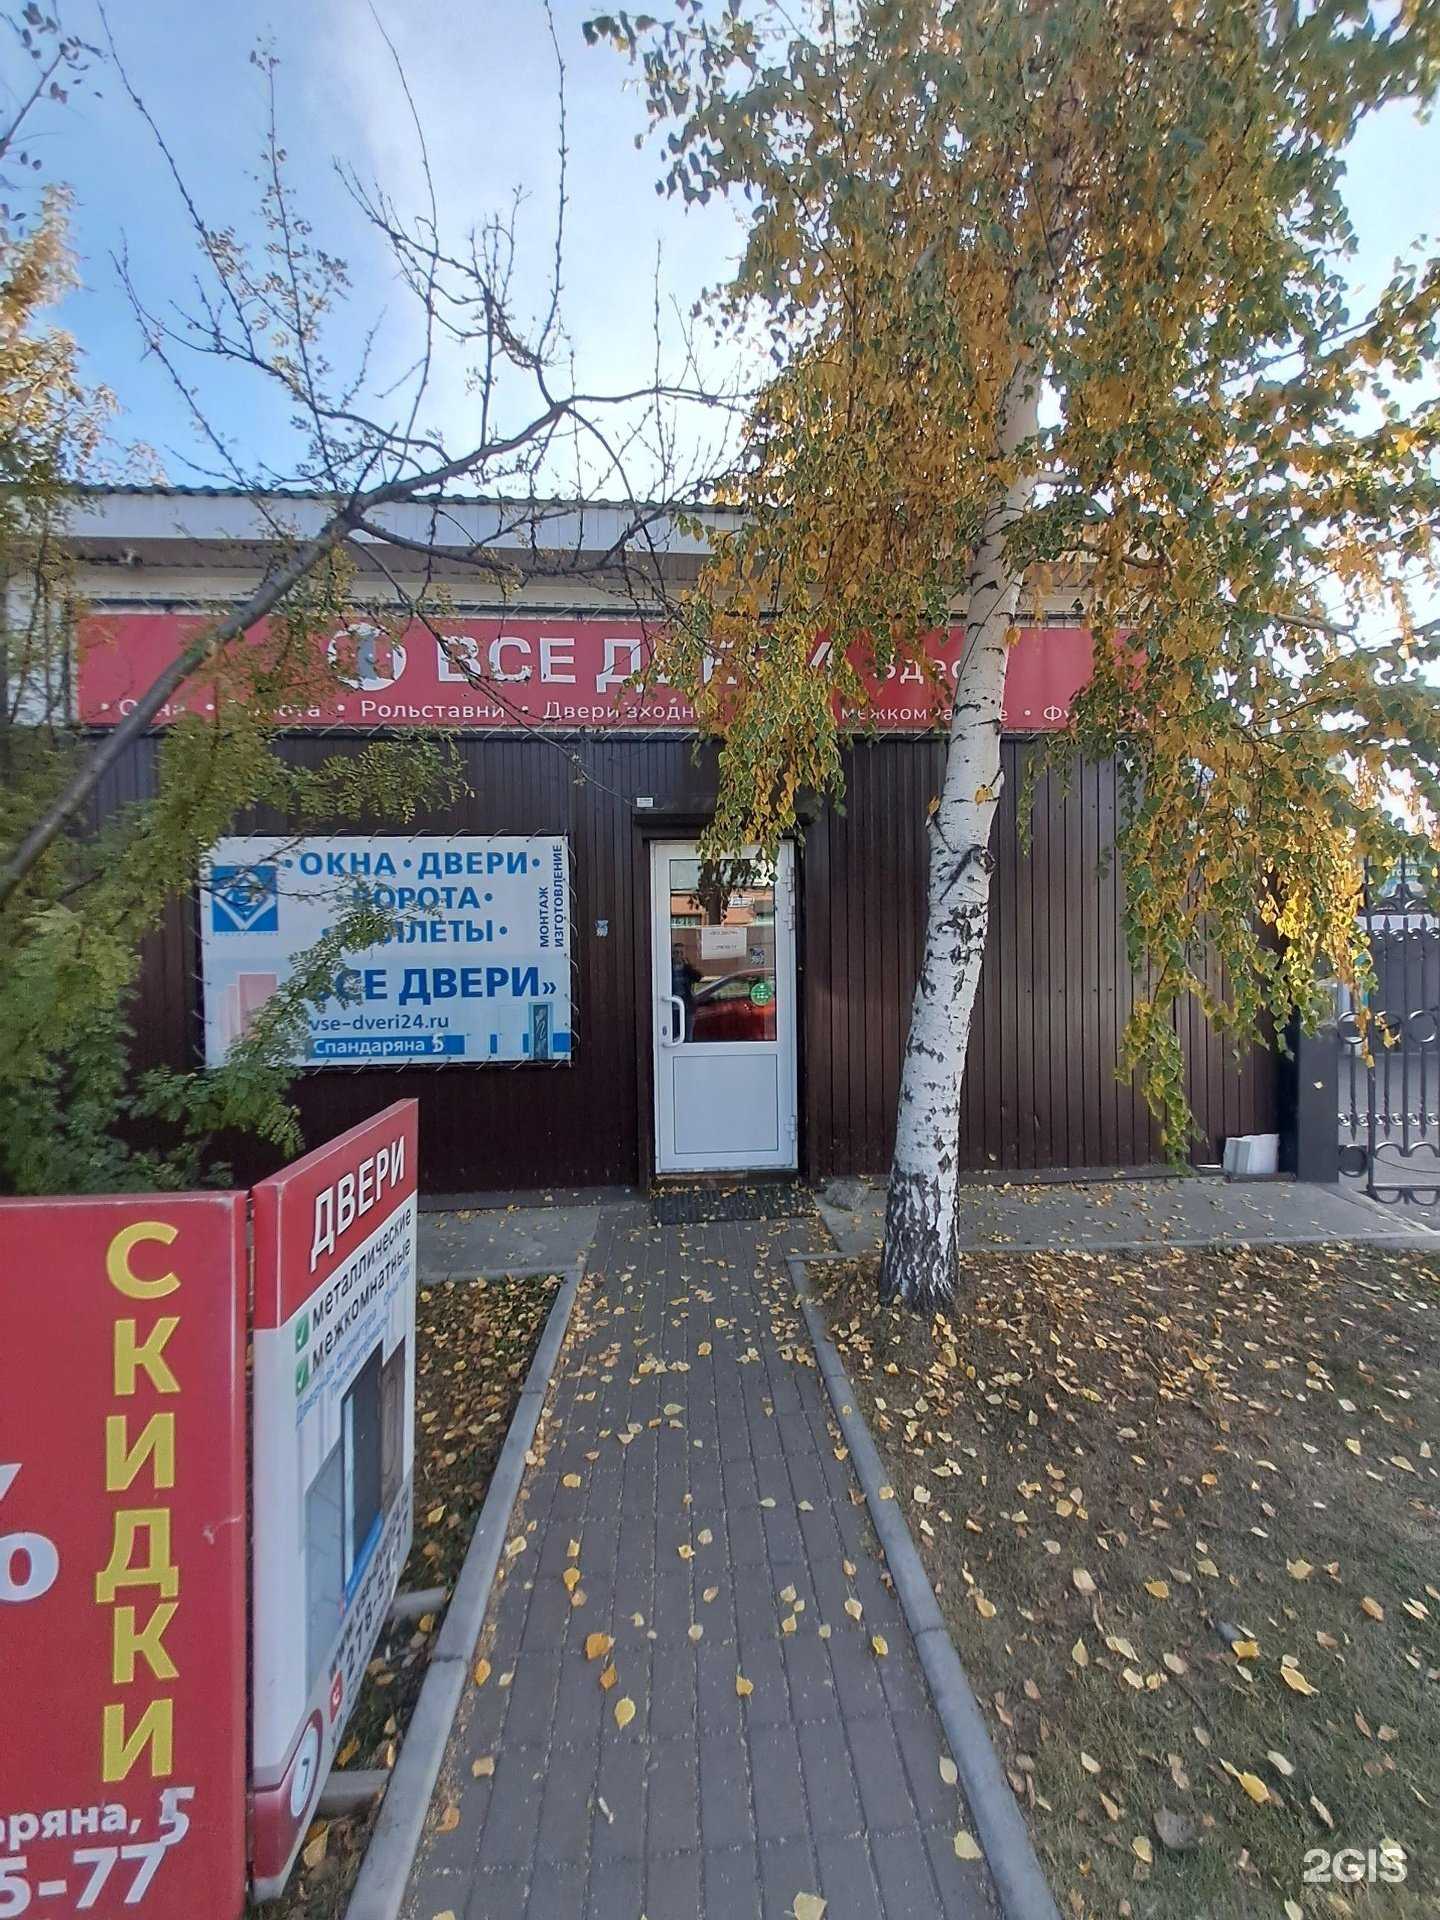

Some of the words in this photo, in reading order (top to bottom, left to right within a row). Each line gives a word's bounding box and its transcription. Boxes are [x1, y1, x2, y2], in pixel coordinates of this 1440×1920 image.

[437, 636, 576, 683] ВСЕ
[543, 702, 620, 721] Двери
[300, 852, 397, 876] ОКНА
[417, 851, 528, 880] ДВЕРИ
[539, 886, 550, 948] МОНТАЖ
[553, 844, 564, 948] ИЗГОТОВЛЕНИЕ
[316, 968, 388, 1001] СЕ
[309, 1013, 449, 1032] vse-dveri24.ru
[313, 1039, 425, 1056] Спандаряна
[310, 1135, 406, 1274] ДВЕРИ
[312, 1207, 411, 1332] металлические
[312, 1236, 411, 1375] межкомнатные
[0, 1802, 142, 1851] ряна,
